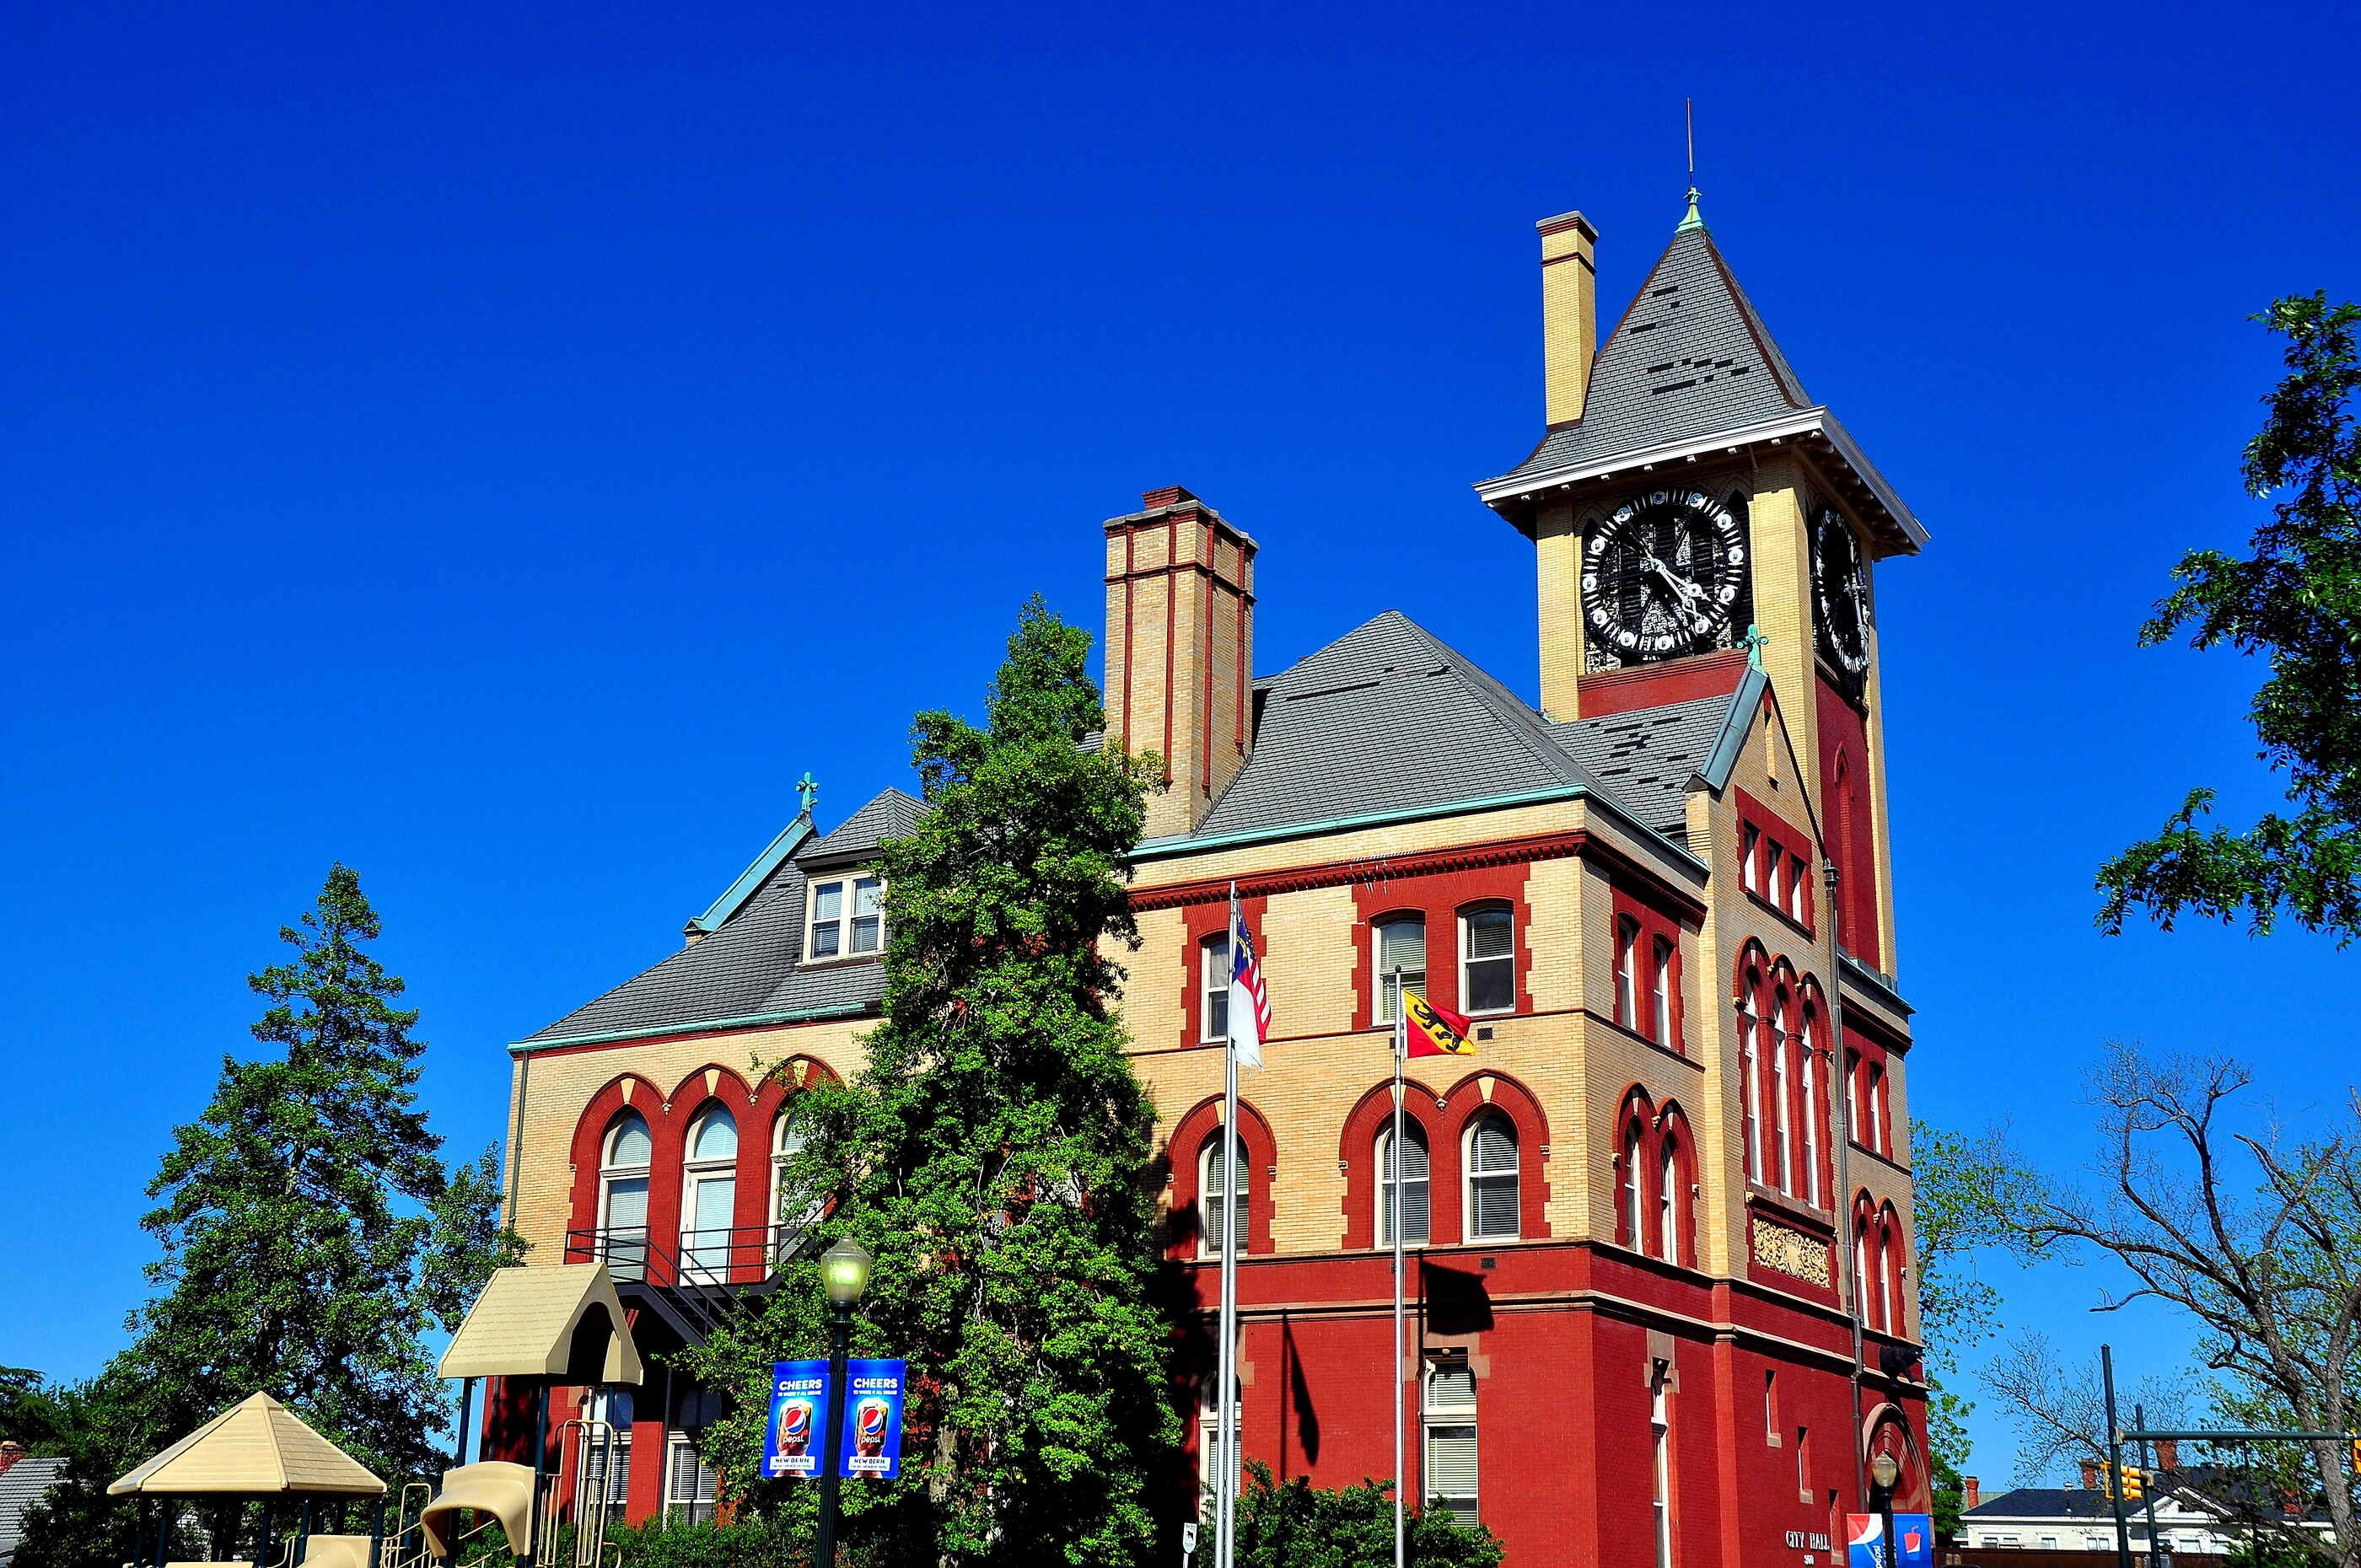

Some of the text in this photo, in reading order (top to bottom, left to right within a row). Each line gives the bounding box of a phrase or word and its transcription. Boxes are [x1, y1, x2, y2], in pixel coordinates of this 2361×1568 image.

[778, 1378, 823, 1391] CHEERS
[853, 1377, 898, 1388] CHEERS
[783, 1434, 804, 1444] pepsi
[861, 1435, 881, 1444] pepsi
[1785, 1530, 1830, 1550] CITY HALL
